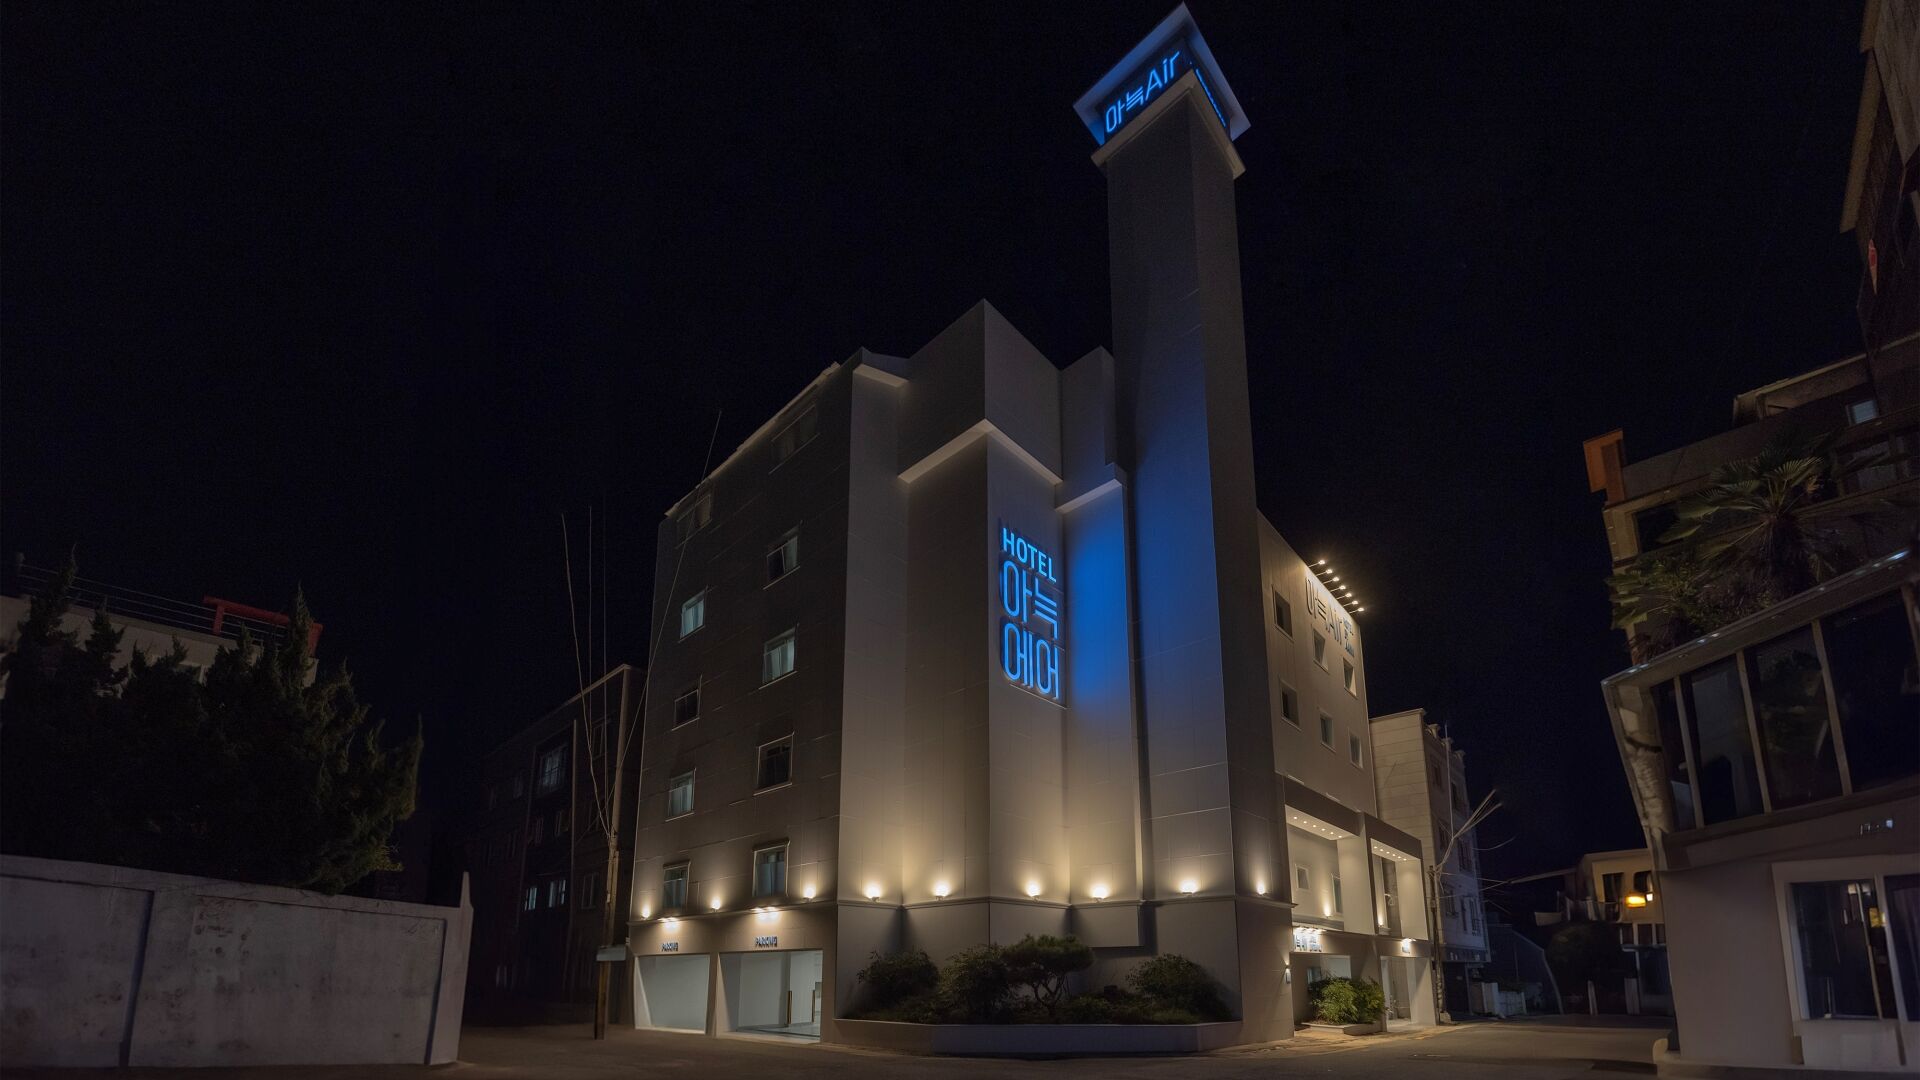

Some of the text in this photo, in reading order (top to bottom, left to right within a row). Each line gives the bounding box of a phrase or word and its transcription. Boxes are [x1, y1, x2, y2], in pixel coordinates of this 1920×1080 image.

[1002, 527, 1057, 582] HOTEL
[1003, 560, 1058, 640] 아늑
[1003, 623, 1060, 700] 에어
